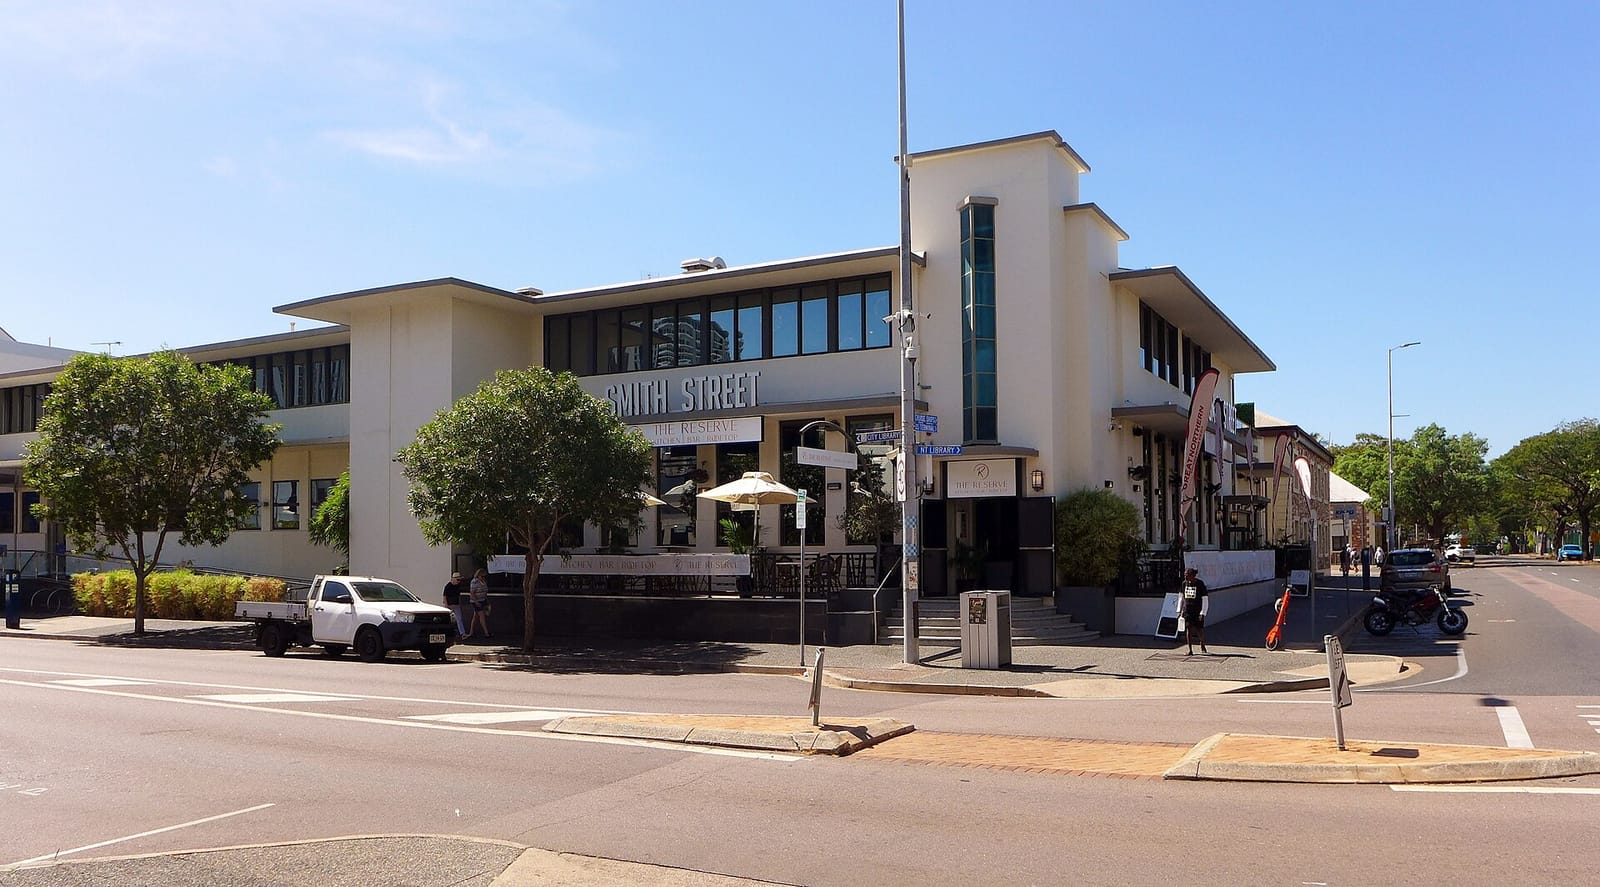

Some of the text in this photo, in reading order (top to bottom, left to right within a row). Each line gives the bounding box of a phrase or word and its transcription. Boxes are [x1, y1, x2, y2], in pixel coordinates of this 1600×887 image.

[607, 371, 761, 417] SMITH STREET
[655, 420, 737, 435] THE RESERVE
[879, 431, 900, 440] LIBRARY
[920, 446, 954, 454] NT LIBRARY
[956, 480, 1007, 489] THE RESERVE
[560, 560, 592, 569] KITCHEN
[599, 560, 614, 569] BAR
[688, 560, 737, 569] THE RESERVE
